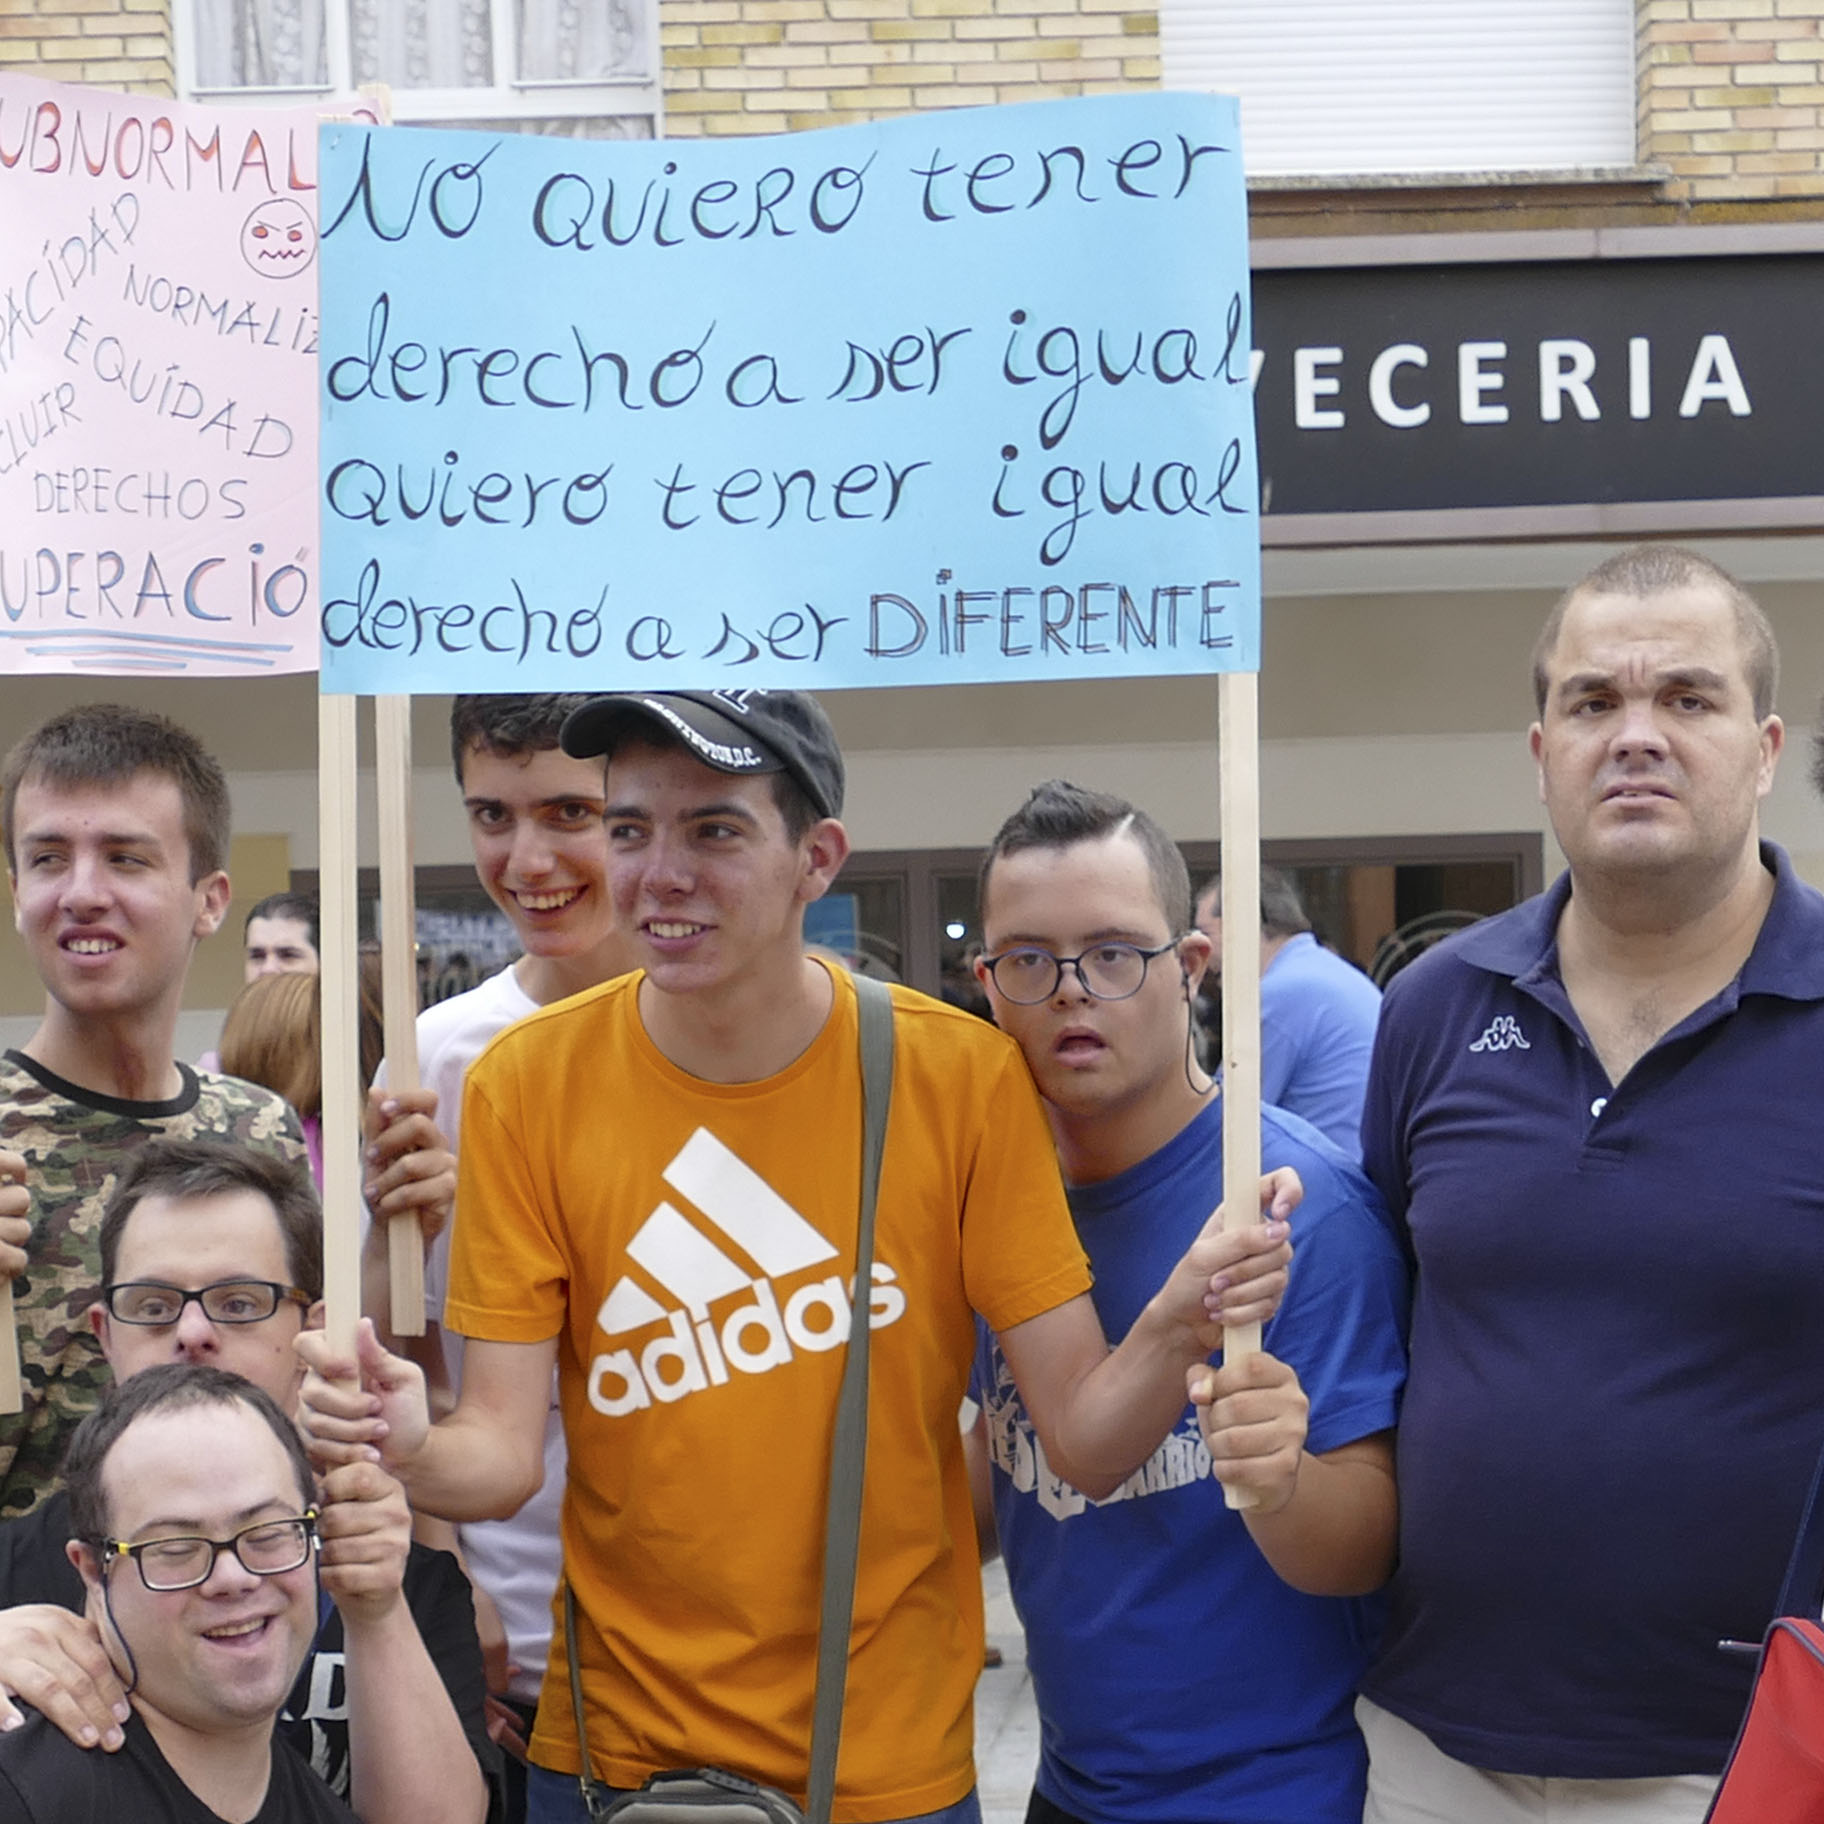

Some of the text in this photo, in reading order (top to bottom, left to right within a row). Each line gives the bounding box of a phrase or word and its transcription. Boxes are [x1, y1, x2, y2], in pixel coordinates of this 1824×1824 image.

[912, 132, 1232, 223] tener
[327, 291, 1248, 451] derecho a ser igual
[34, 466, 248, 520] DERECHOS
[654, 457, 932, 529] tener
[991, 438, 1250, 567] igual
[320, 557, 609, 662] derecho
[626, 613, 684, 661] a
[701, 602, 851, 663] ser
[587, 1262, 907, 1418] adidas
